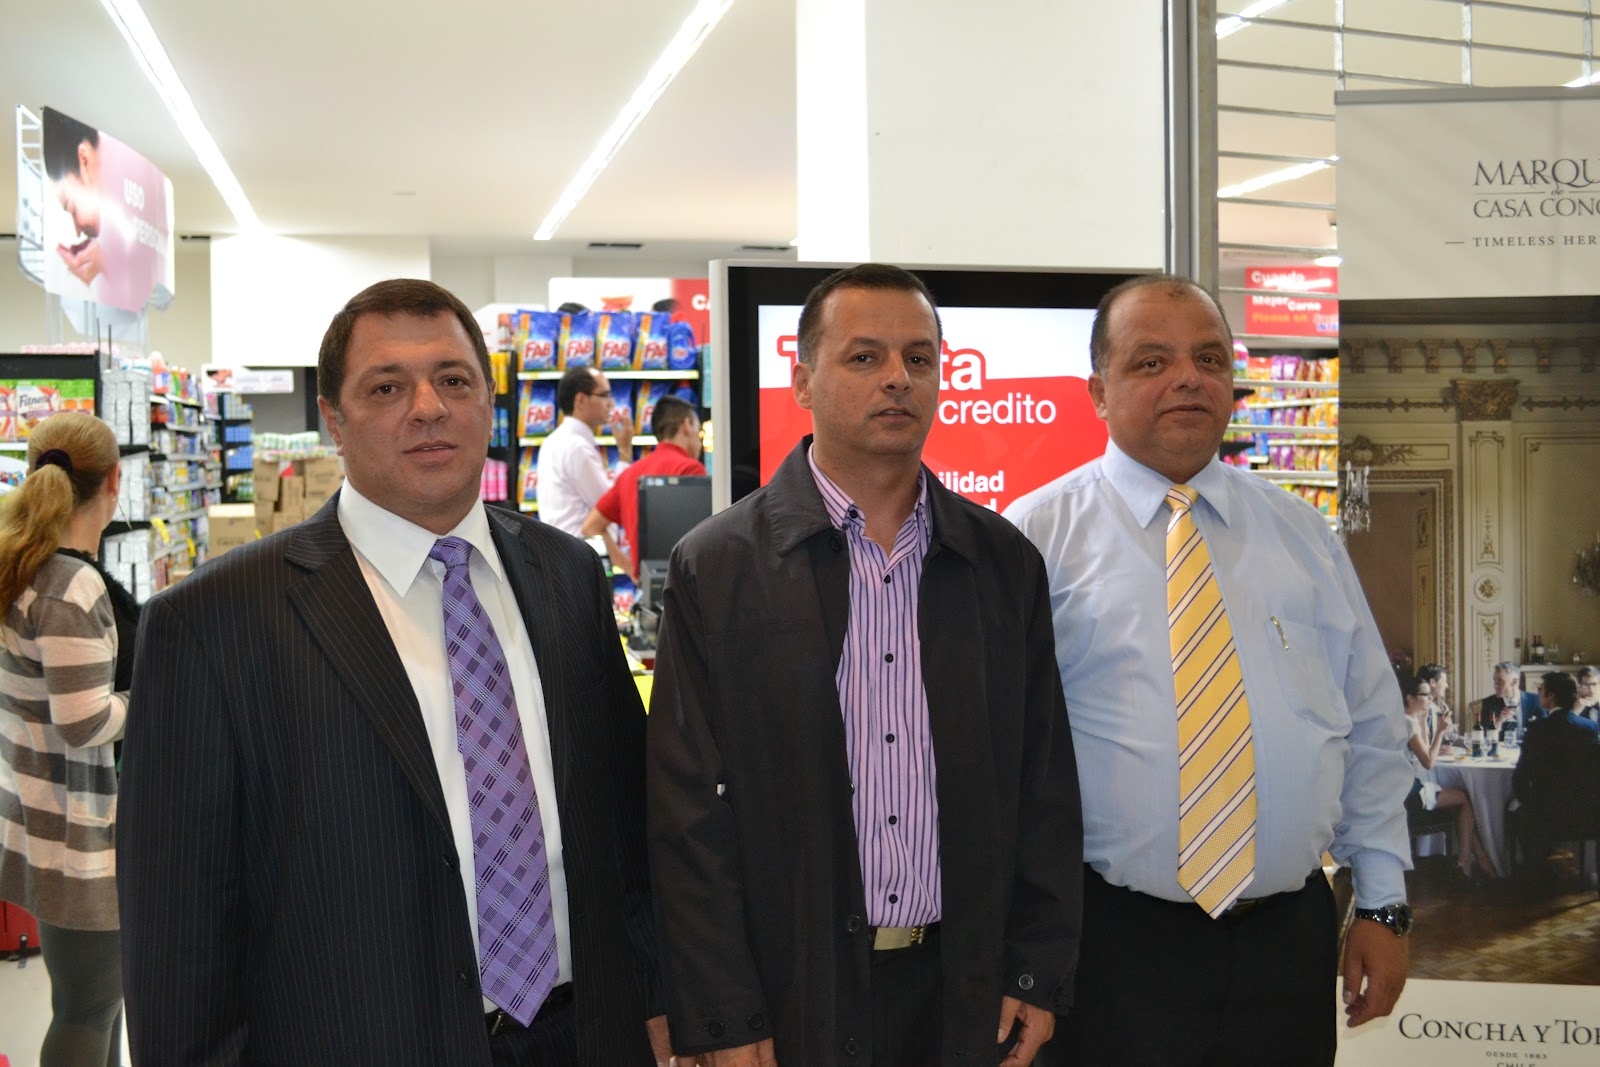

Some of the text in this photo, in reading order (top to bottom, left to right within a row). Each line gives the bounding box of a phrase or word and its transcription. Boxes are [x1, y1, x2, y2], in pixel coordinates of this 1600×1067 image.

[124, 177, 145, 211] USO
[1473, 198, 1600, 218] CASA CON
[1473, 236, 1555, 247] TIMELESS
[525, 341, 553, 358] FAB
[566, 340, 594, 357] FAB
[602, 341, 631, 358] FAB
[526, 405, 553, 423] FAB
[939, 393, 1057, 424] credito
[938, 470, 1004, 493] ilidad
[1532, 1025, 1551, 1043] Y
